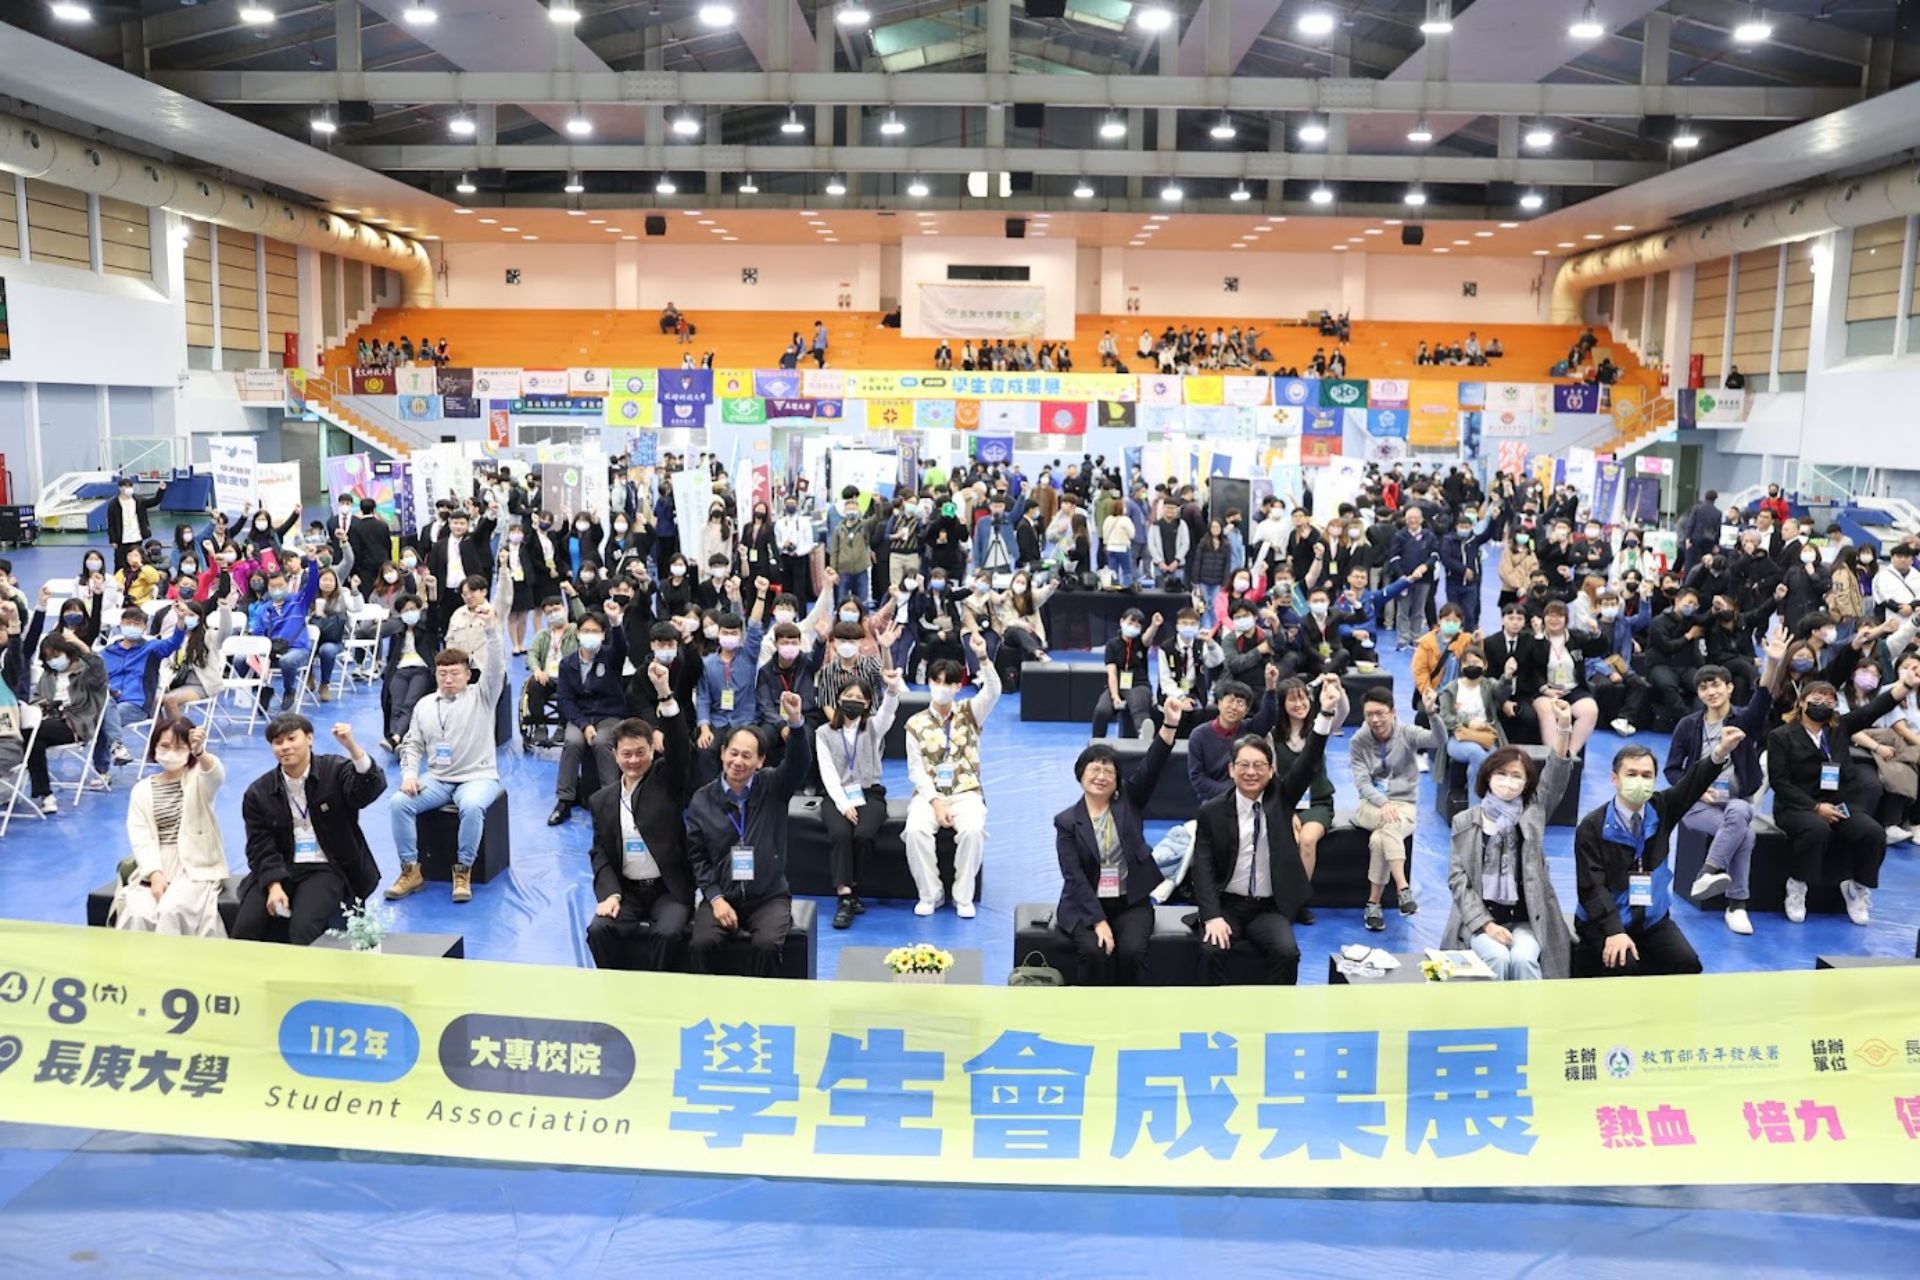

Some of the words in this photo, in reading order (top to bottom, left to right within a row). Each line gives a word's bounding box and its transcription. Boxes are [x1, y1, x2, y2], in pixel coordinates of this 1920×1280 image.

[952, 377, 1061, 395] 學生會成果展
[311, 1027, 388, 1059] 112年
[470, 1036, 602, 1076] 大專校院
[1565, 1048, 1597, 1064] 主辦
[1641, 1046, 1780, 1064] 教育部青年發展署
[34, 1039, 230, 1098] 長庚大學
[669, 1019, 1537, 1158] 學生會成果展
[264, 1085, 401, 1118] Student
[426, 1099, 631, 1135] Association
[1596, 1104, 1696, 1148] 熱血
[1743, 1100, 1846, 1143] 培力
